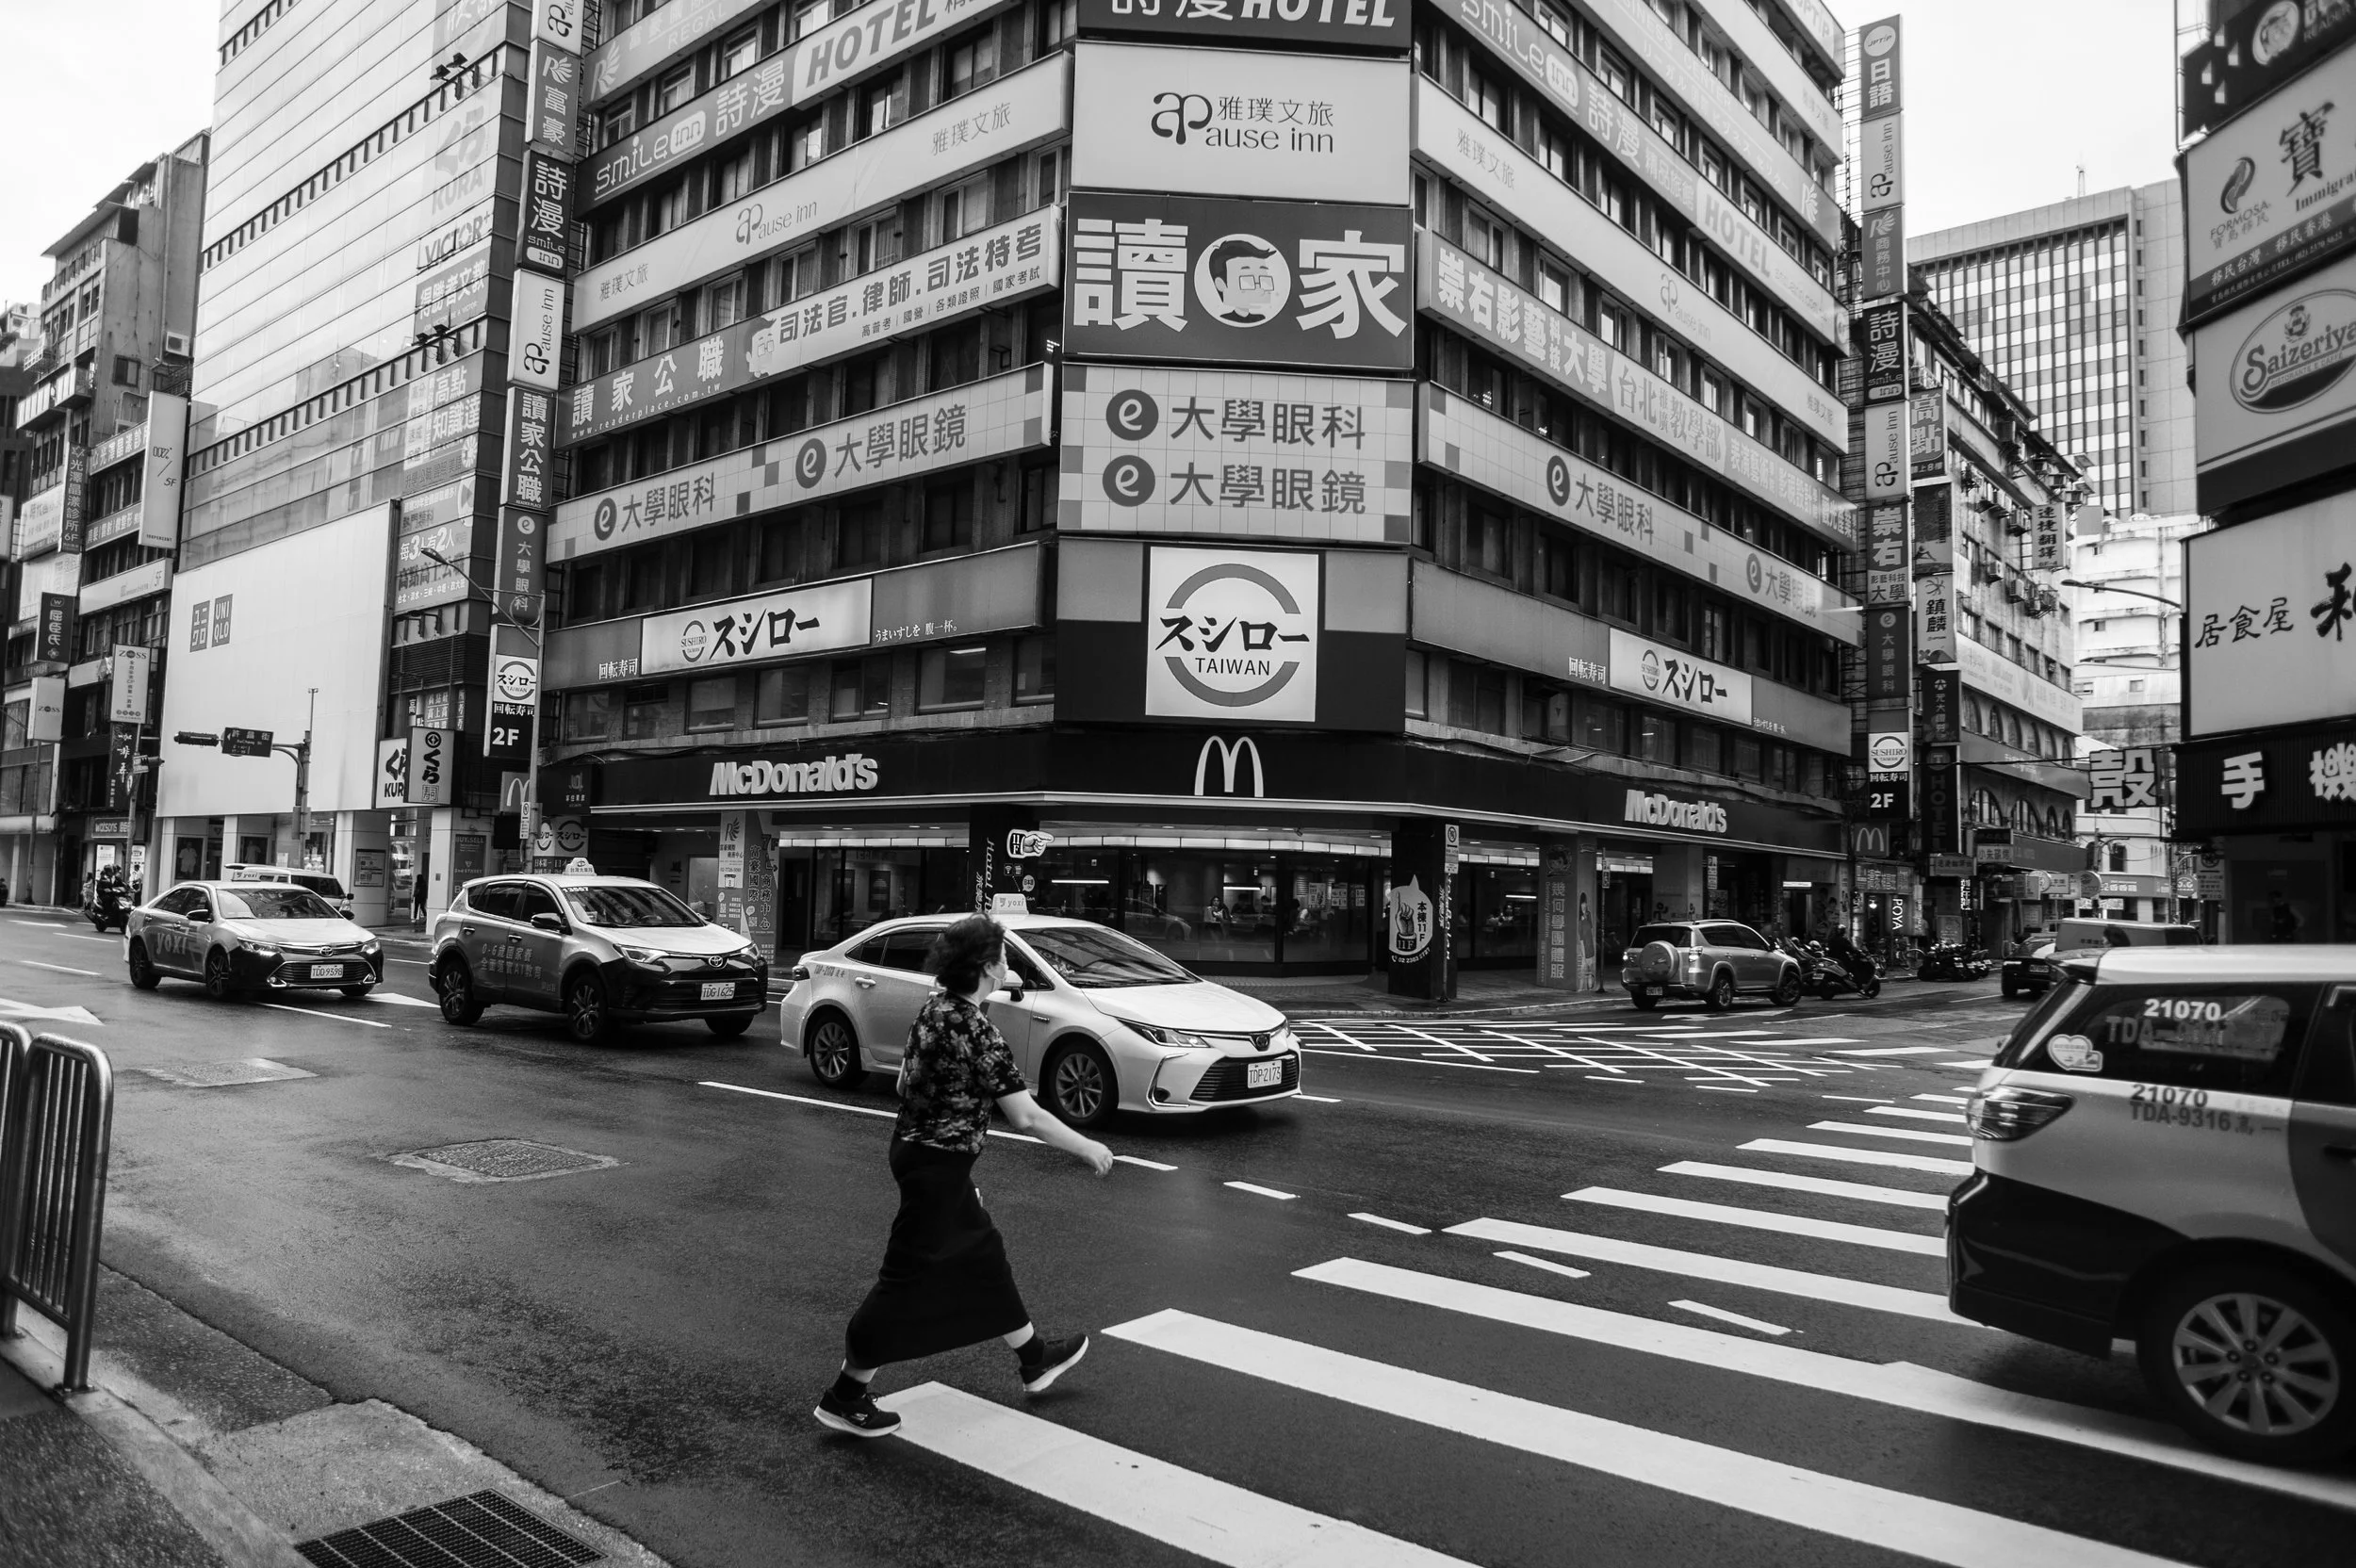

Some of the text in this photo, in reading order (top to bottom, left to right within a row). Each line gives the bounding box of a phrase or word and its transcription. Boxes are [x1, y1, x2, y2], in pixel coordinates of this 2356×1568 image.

[668, 8, 728, 49] REGAL
[806, 0, 938, 89] HOTEL
[715, 59, 785, 138] 詩漫
[1550, 60, 1577, 99] inn
[1683, 52, 1731, 108] CENTER
[1869, 57, 1893, 109] 日語
[542, 85, 569, 146] 富豪
[930, 102, 1012, 156] 雅璞文旅
[1218, 95, 1334, 127] 雅璞文旅
[1587, 81, 1641, 169] 詩漫
[595, 119, 702, 194] smile inn
[1290, 127, 1334, 154] inn
[1457, 127, 1515, 190] 雅璞文旅
[2279, 101, 2335, 197] 寶
[432, 164, 483, 215] KURA
[530, 160, 567, 239] 詩漫
[795, 201, 818, 225] inn
[2210, 200, 2269, 239] FORMOSA
[527, 235, 566, 253] smile
[1705, 193, 1772, 278] HOTEL
[2210, 211, 2332, 287] 移民台灣 移民香港
[541, 287, 555, 311] inn
[598, 263, 649, 302] 雅璞文旅
[992, 265, 1041, 295] 國家考試
[1868, 309, 1901, 373] 詩漫
[434, 365, 467, 406] 高點
[571, 335, 725, 428] 讀家公職
[1868, 373, 1904, 387] smile
[432, 395, 481, 443] 知識達
[571, 382, 721, 440] www.readerplace.com.tw
[1170, 397, 1366, 450] 大學眼科
[1910, 393, 1942, 456] 高點
[516, 392, 548, 503] 讀家公職
[834, 403, 966, 479] 大學眼鏡
[164, 477, 177, 486] 5F
[1170, 462, 1366, 514] 大學眼鏡
[621, 471, 715, 533] 大學眼科
[1576, 473, 1654, 546] 大學眼科
[64, 533, 80, 542] 6F
[1872, 506, 1902, 567] 崇右
[515, 540, 532, 612] 大學眼科
[1872, 583, 1906, 601] 大學
[216, 600, 230, 621] UNI
[2194, 596, 2294, 649] 居食屋
[214, 621, 229, 644] QLO
[681, 634, 708, 649] SUSHIRO
[709, 608, 821, 661] スシロー
[875, 624, 921, 644] うまいすしを
[1154, 615, 1310, 653] スシロー
[496, 674, 536, 686] スシロー
[598, 658, 639, 681] 回転寿司
[1195, 657, 1270, 676] TAIWAN
[1568, 656, 1606, 685] 回転寿司
[1661, 658, 1727, 704] スシロー
[1881, 632, 1895, 693] 大學眼科
[492, 727, 519, 746] 2F
[1871, 748, 1907, 757] SUSHIRO
[422, 749, 442, 784] くら
[709, 753, 879, 796] McDonald's
[1870, 773, 1908, 783] 回転寿司
[384, 782, 404, 797] KUR
[1870, 793, 1894, 808] 2F
[95, 822, 118, 833] watsons
[1624, 789, 1727, 833] McDonald's
[1930, 775, 1947, 853] HOTEL
[761, 833, 779, 851] 7F
[1012, 834, 1020, 844] 11
[748, 844, 761, 903] 富豪國際
[760, 874, 772, 930] 商務中心
[1007, 897, 1024, 907] yoxi
[1891, 898, 1904, 930] POYA
[156, 933, 188, 956] yoxi
[2143, 998, 2222, 1021] 21070
[1249, 1066, 1281, 1085] TDP-2173
[2130, 1083, 2209, 1108] 21070
[2129, 1101, 2232, 1132] TDA-9316
